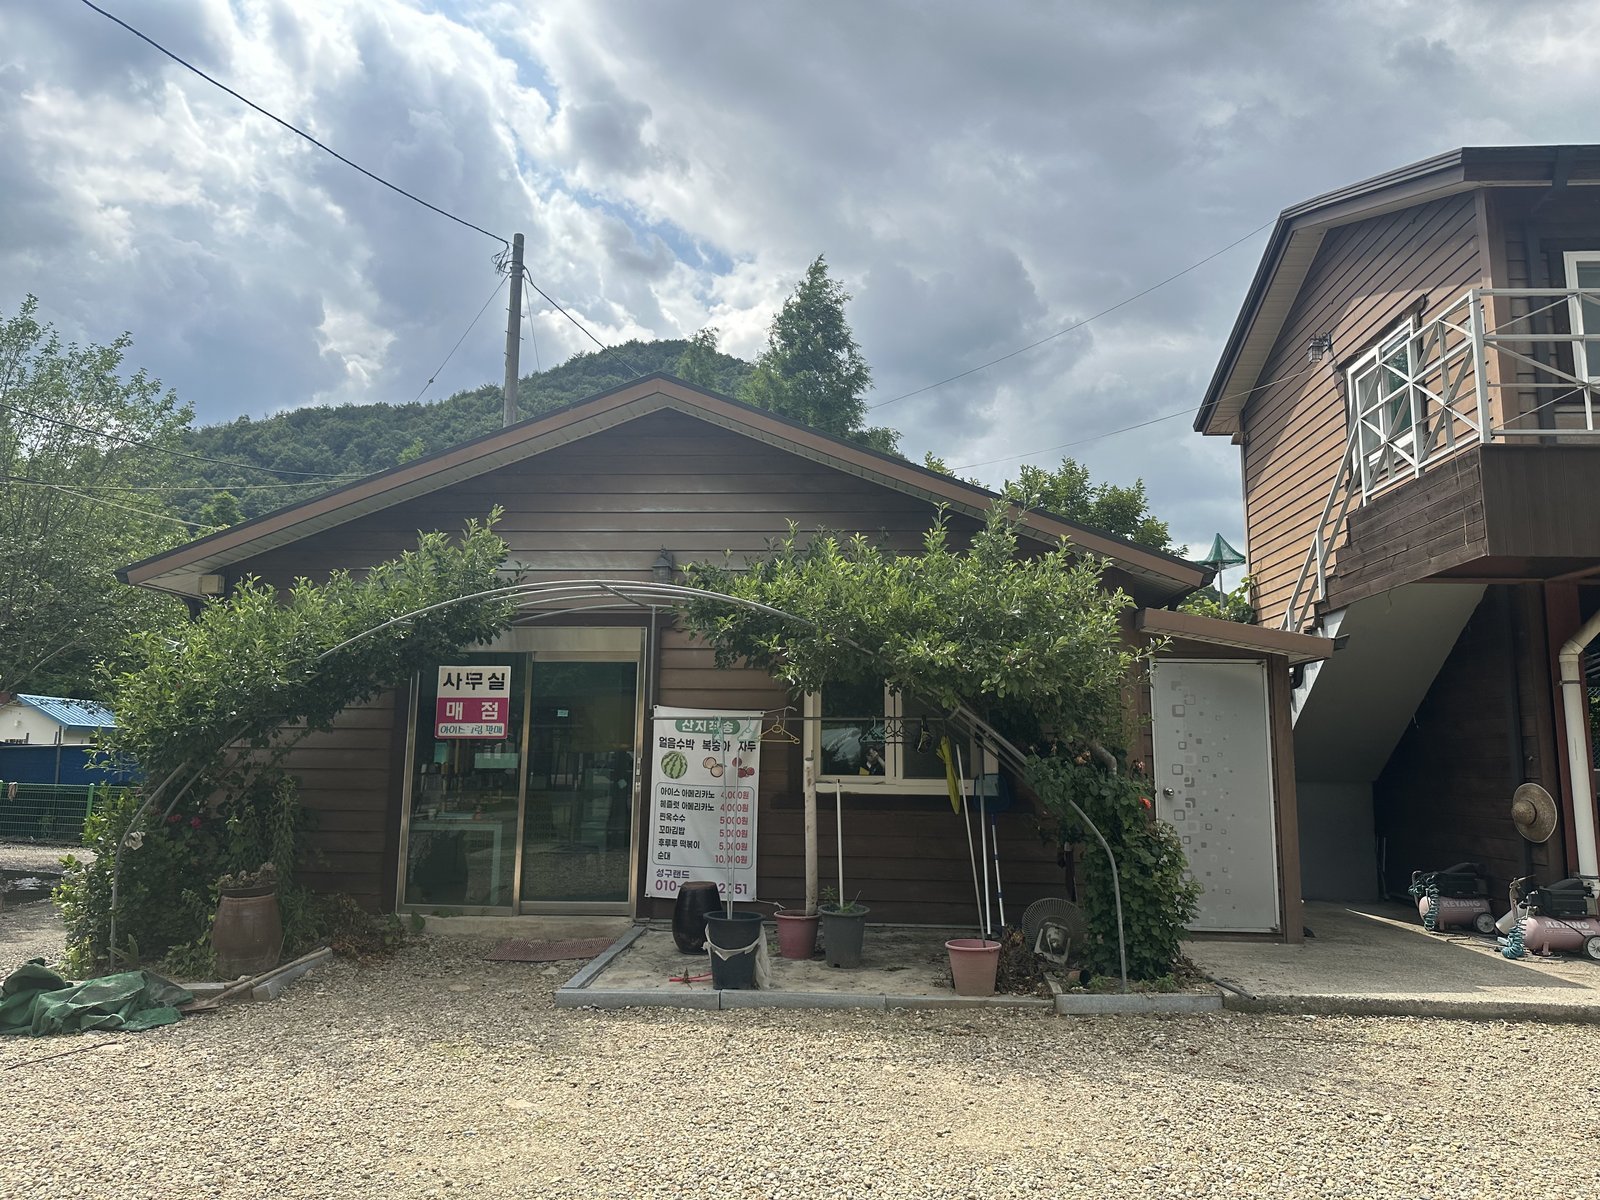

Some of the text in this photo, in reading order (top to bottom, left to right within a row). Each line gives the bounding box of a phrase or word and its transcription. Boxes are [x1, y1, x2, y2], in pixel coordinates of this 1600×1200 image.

[443, 672, 505, 690] 사무실
[486, 724, 503, 735] 판매
[659, 736, 756, 752] 얼음수박 복숭아 자두
[660, 787, 680, 796] 아이스
[682, 788, 715, 799] 아메리카노
[682, 801, 715, 811] 아메리카노
[720, 803, 749, 812] 4000원
[719, 816, 748, 826] 500원
[659, 825, 748, 838] 꼬마김밥 500원
[679, 839, 700, 849] 떡볶이
[657, 851, 671, 861] 순대
[656, 868, 690, 879] 성구랜드
[1442, 900, 1481, 908] KEYANG
